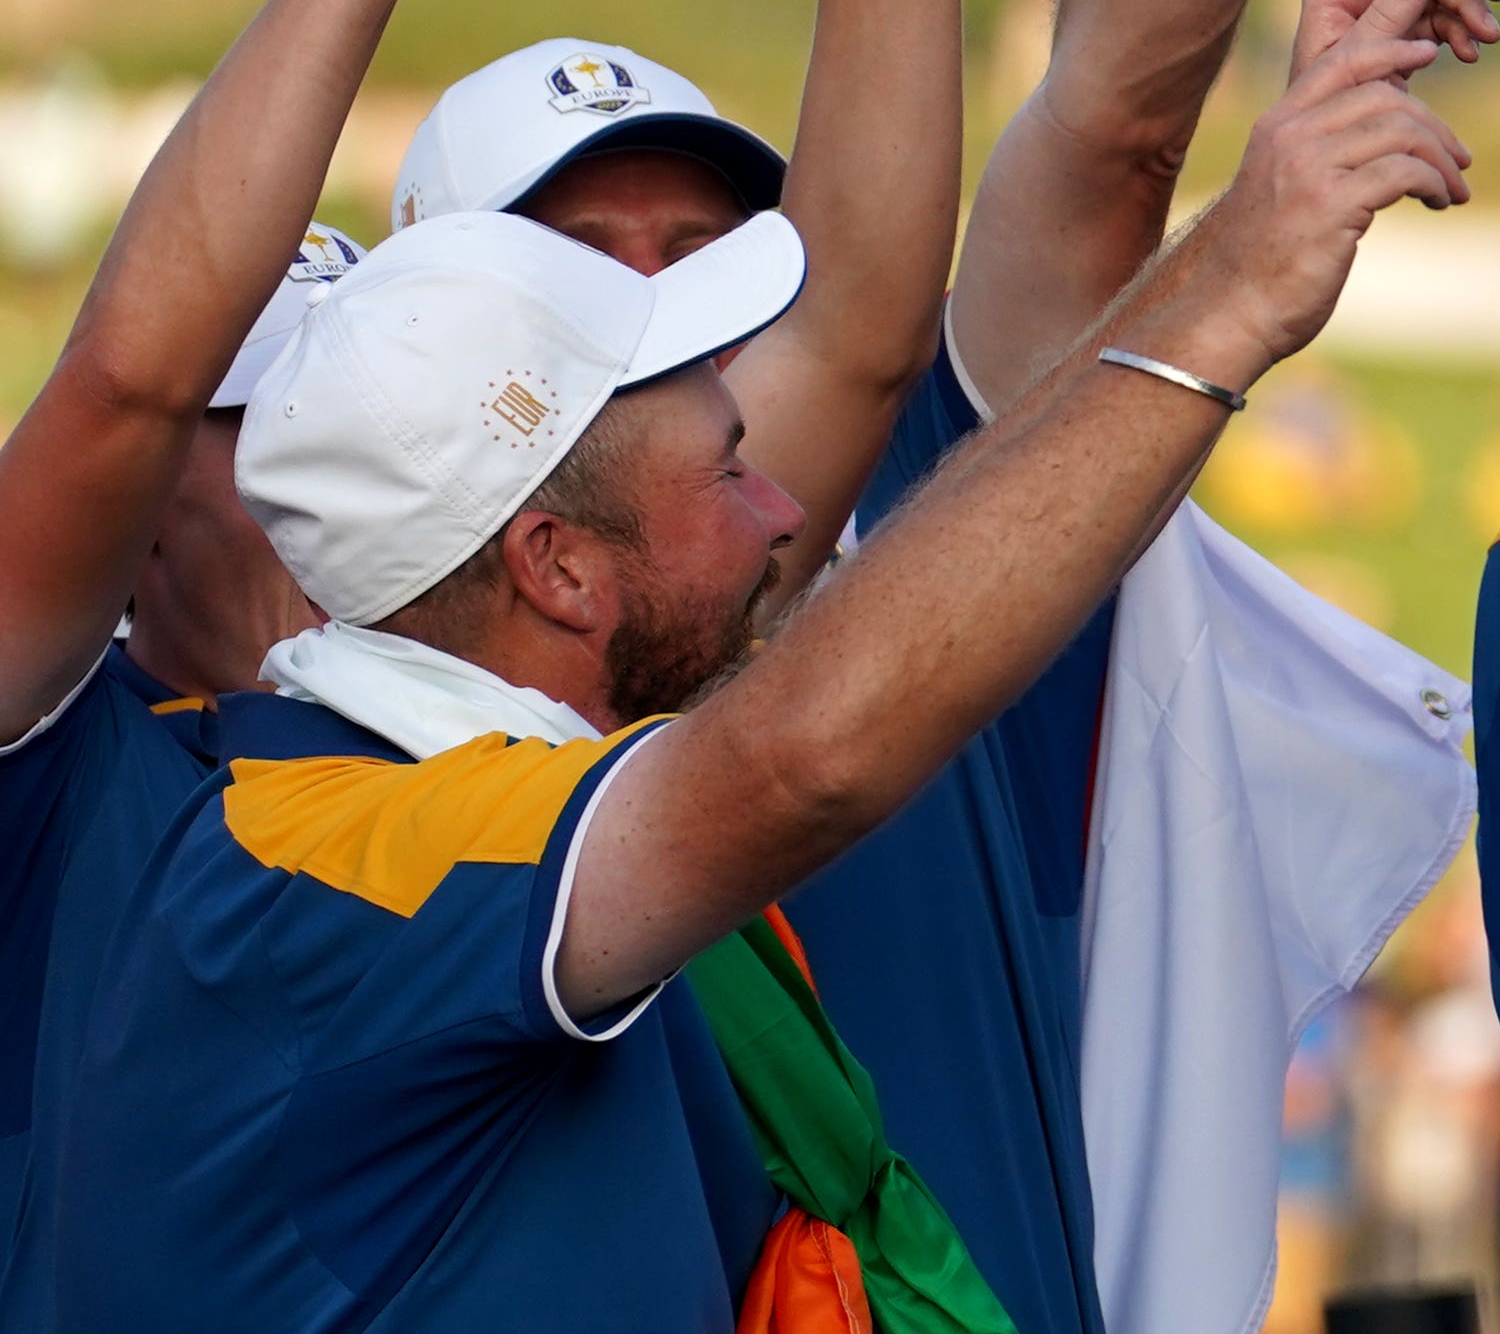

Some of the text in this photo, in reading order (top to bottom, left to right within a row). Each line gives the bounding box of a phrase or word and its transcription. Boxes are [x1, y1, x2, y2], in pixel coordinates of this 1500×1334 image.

[571, 88, 635, 104] EUROPE
[303, 264, 353, 275] EURO
[491, 381, 550, 437] EUR
